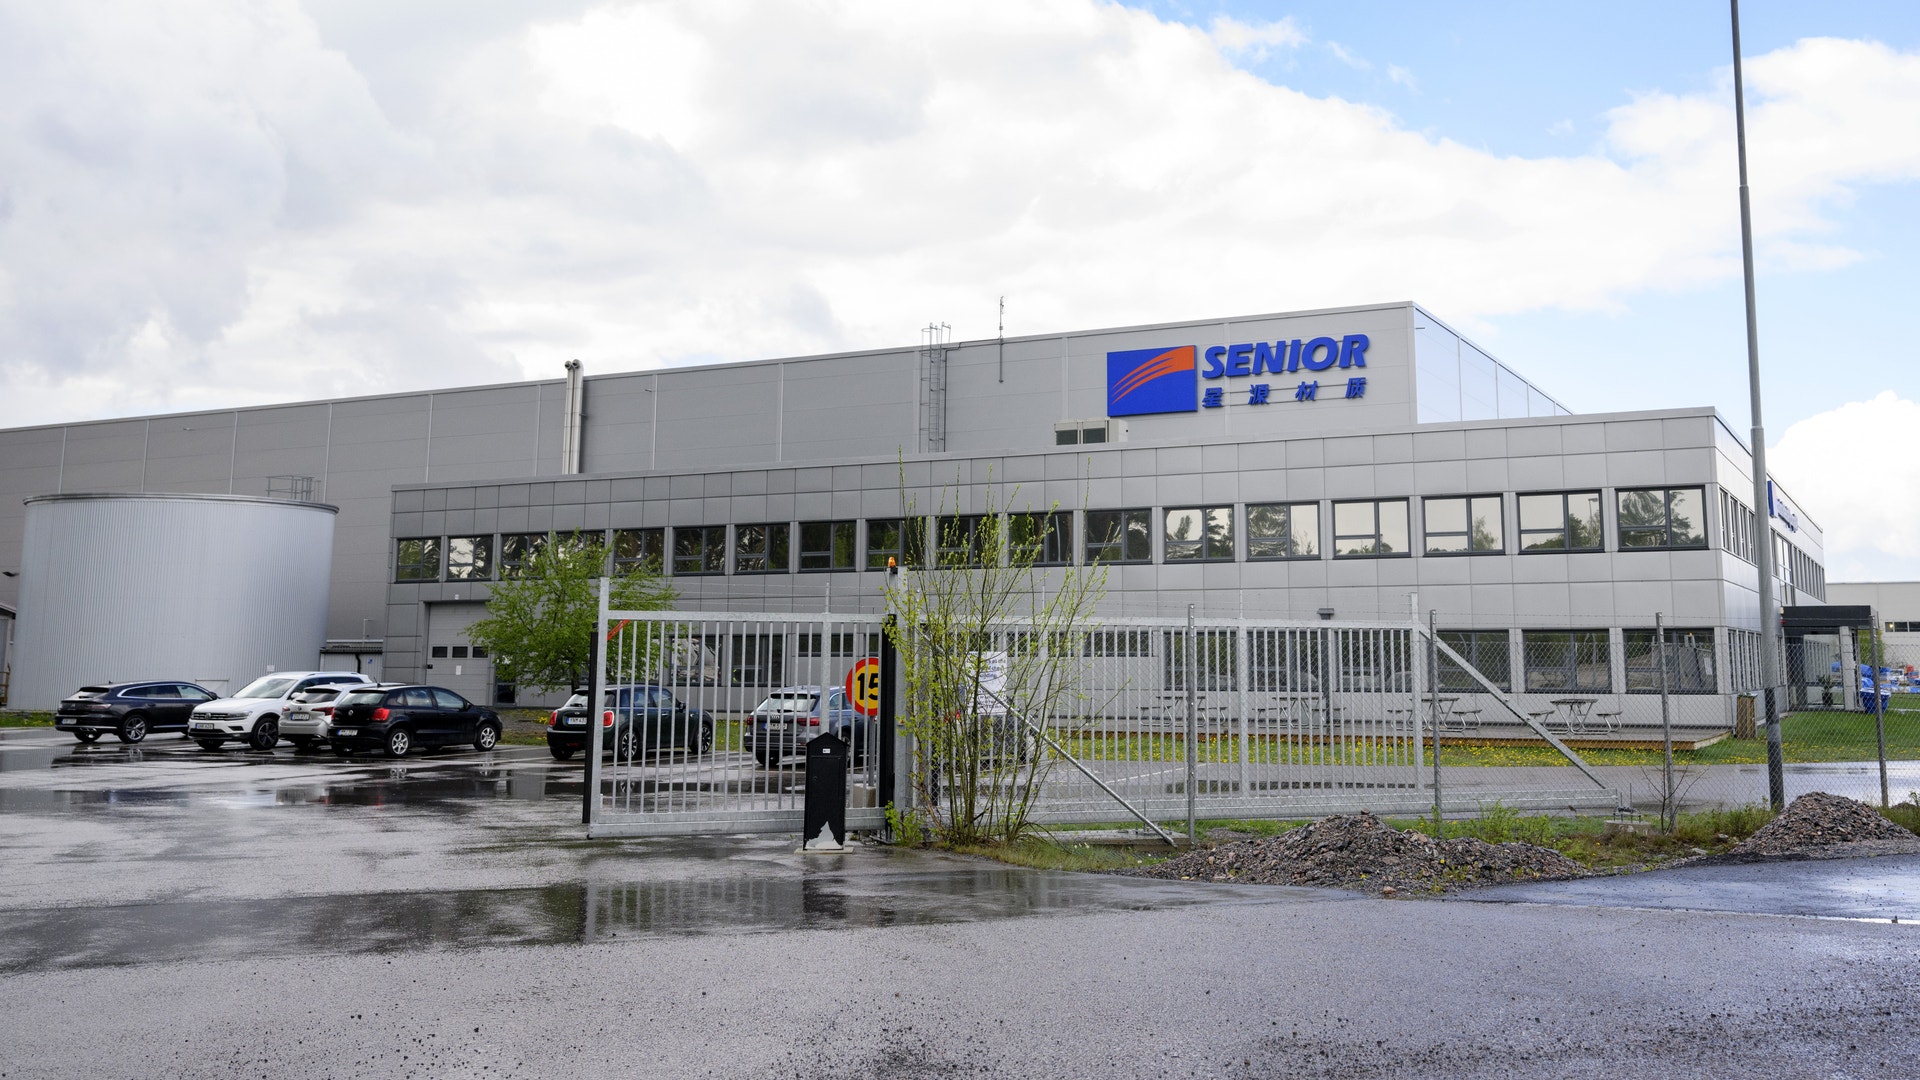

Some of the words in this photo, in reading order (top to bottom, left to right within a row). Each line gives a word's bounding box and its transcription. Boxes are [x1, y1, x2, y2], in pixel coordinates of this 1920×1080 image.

[1202, 334, 1370, 379] SENIOR
[1202, 377, 1366, 408] 星源材质
[857, 672, 880, 701] 15
